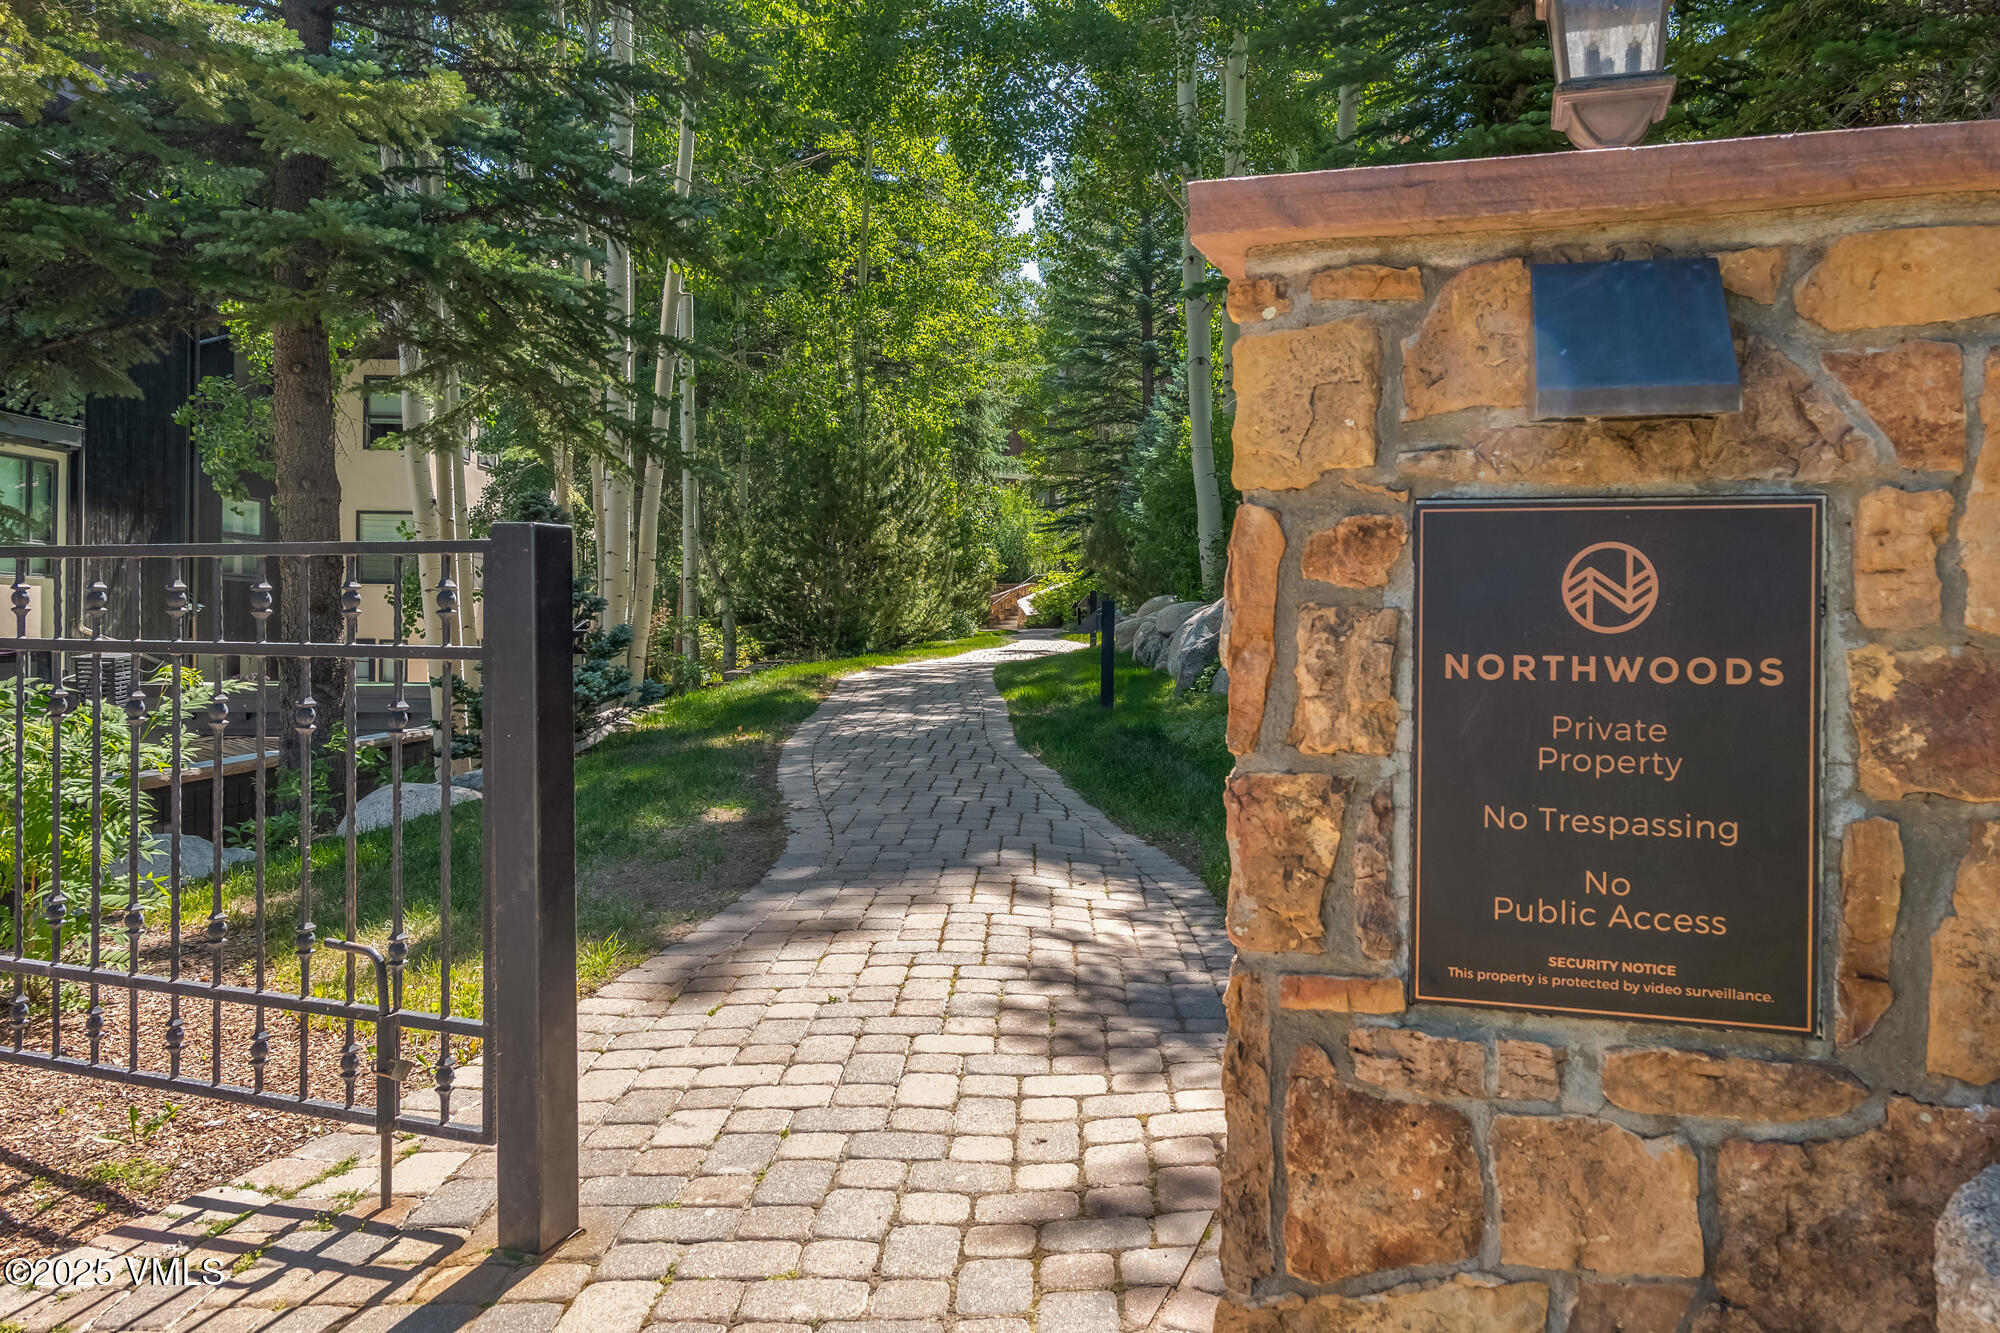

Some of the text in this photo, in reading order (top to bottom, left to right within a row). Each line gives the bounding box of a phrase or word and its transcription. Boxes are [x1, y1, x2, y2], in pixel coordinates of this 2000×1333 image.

[1445, 653, 1784, 686] NORTHWOODS
[1553, 716, 1667, 742] Private
[1539, 747, 1682, 781] Property
[1484, 805, 1738, 846] No Trespassing
[1586, 870, 1630, 896] No
[1494, 897, 1726, 935] Public Access
[1548, 956, 1676, 976] SECURITY NOTICE
[1448, 967, 1775, 1003] This property is protected by video surveillance.
